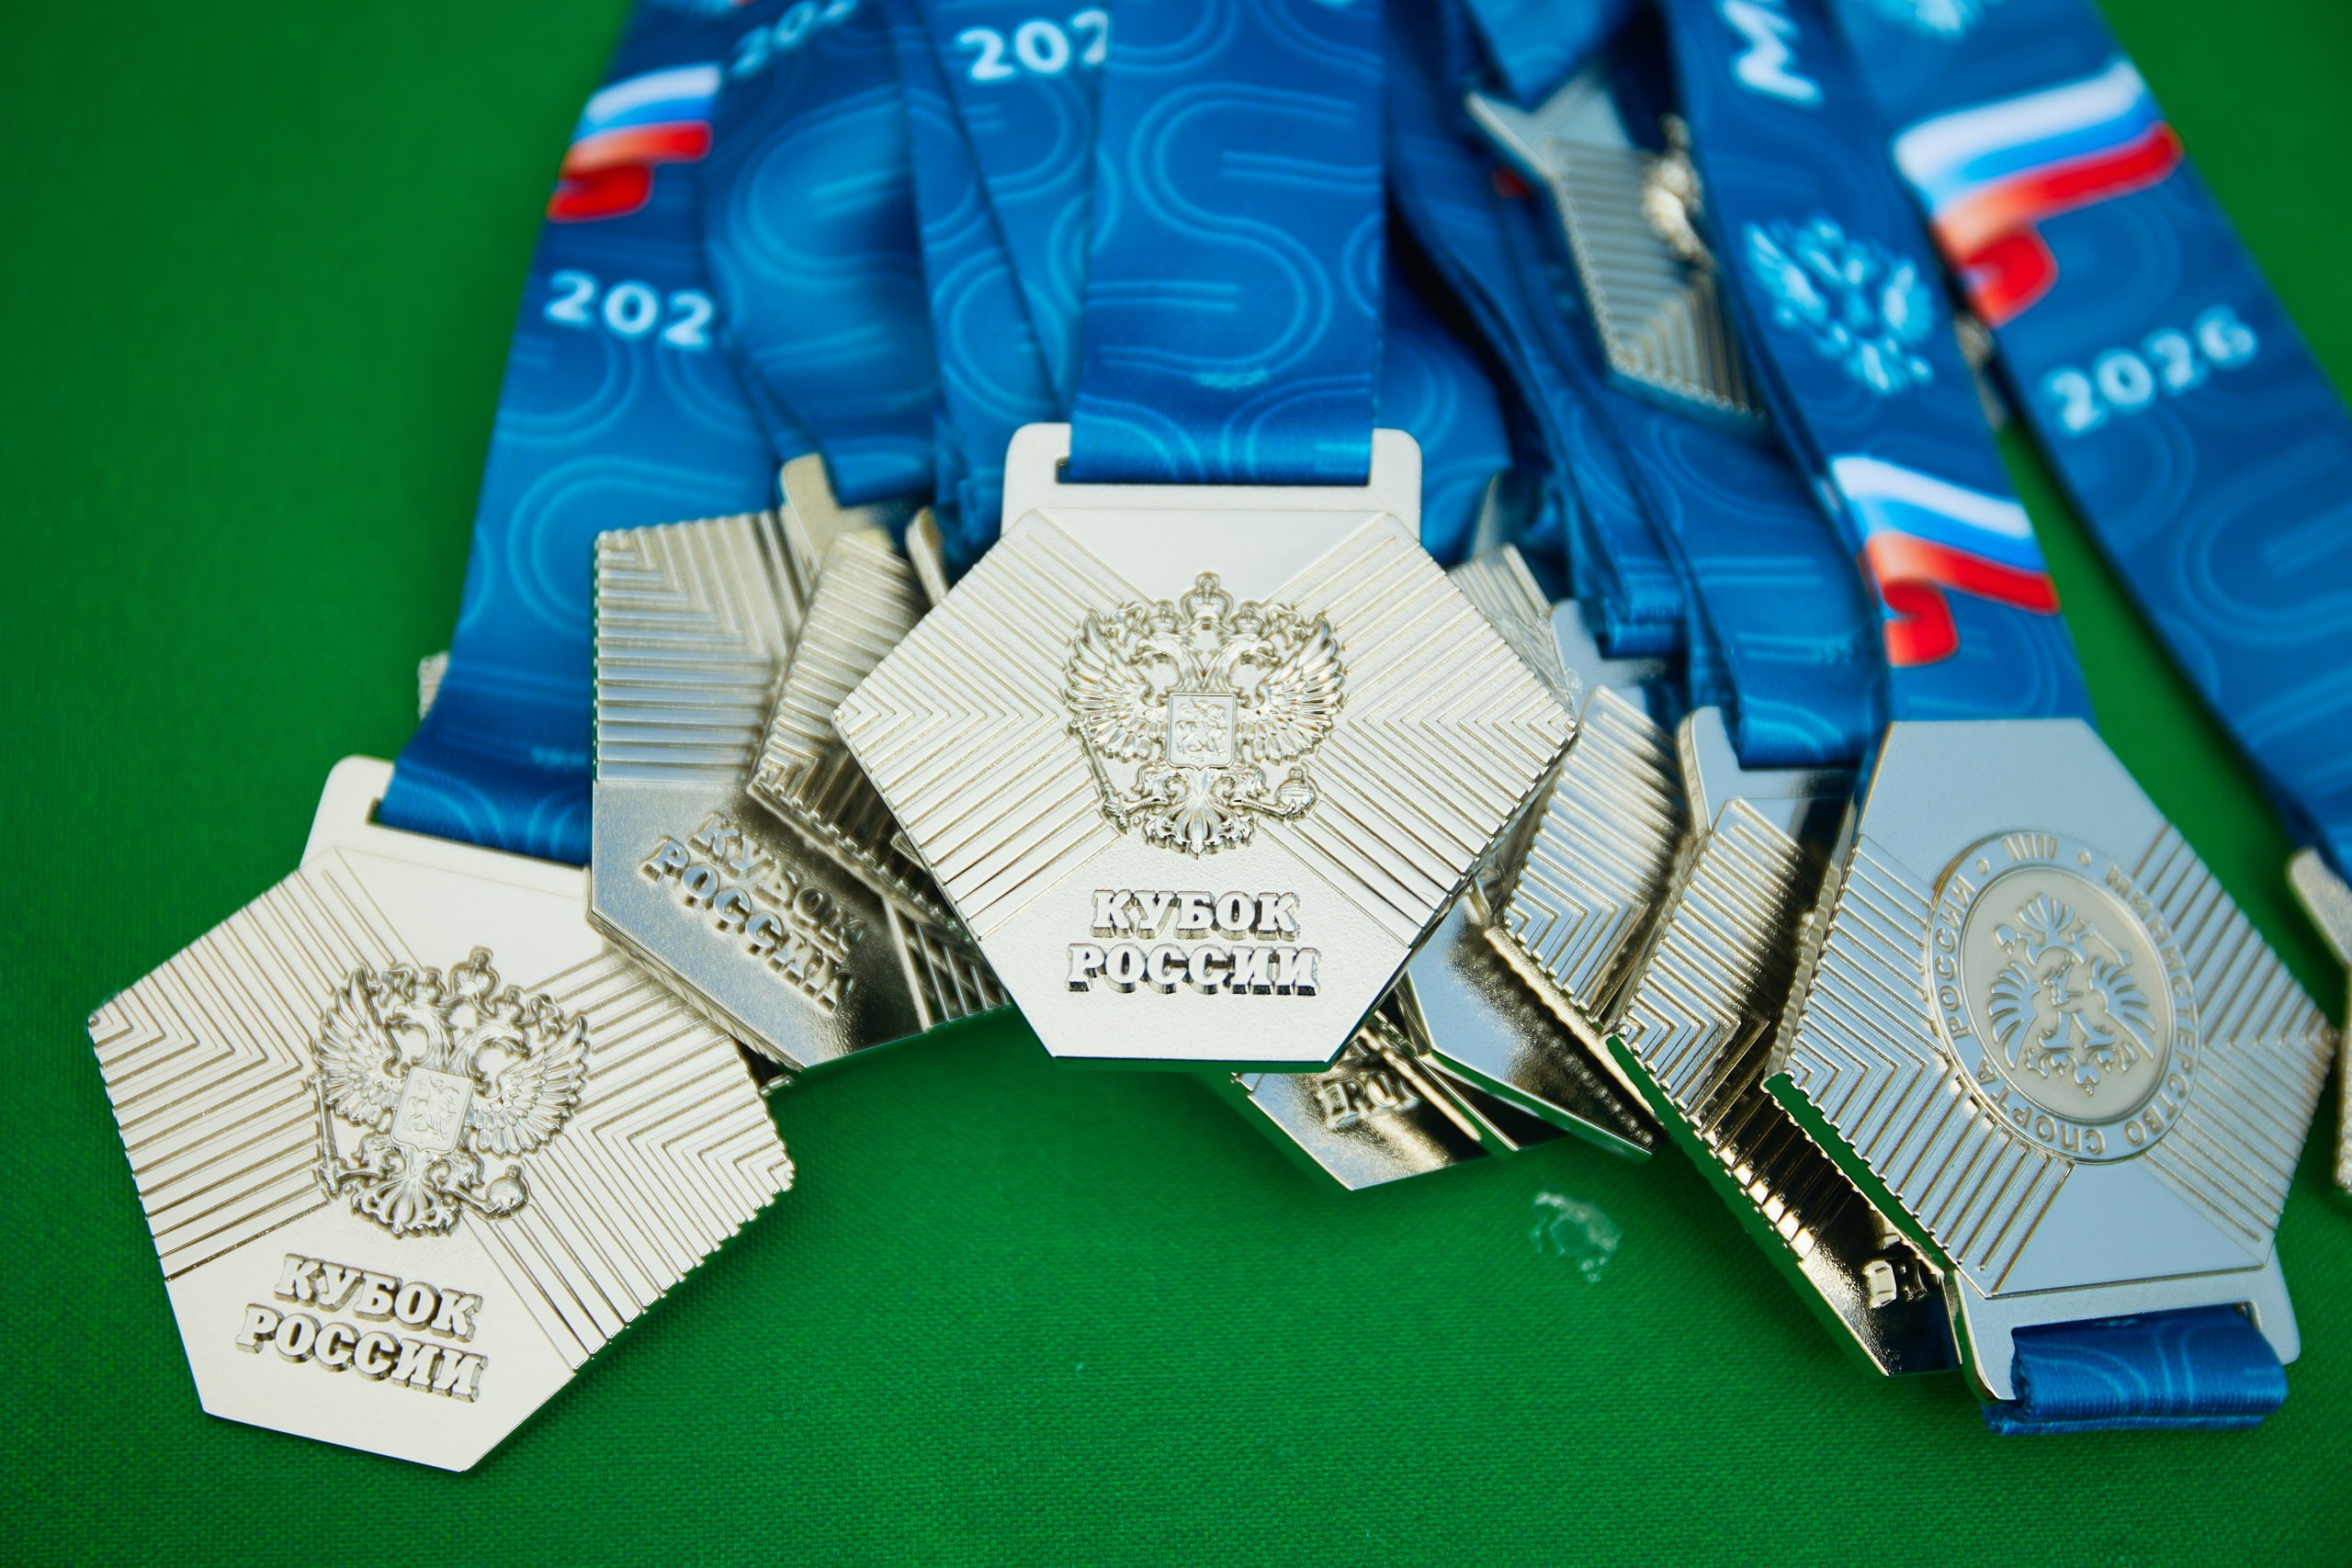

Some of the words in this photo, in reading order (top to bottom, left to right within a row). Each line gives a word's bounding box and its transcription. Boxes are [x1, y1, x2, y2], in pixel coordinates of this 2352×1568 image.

[956, 8, 1109, 83] 202
[544, 269, 714, 349] 202
[2044, 305, 2257, 434] 2026
[639, 834, 856, 1014] РОССИИ
[687, 809, 865, 964] КУБОК
[1090, 888, 1301, 942] КУБОК
[1065, 942, 1322, 997] РОССИИ
[1934, 874, 1976, 1041] РОССИИ
[1976, 1055, 2107, 1156] СПОРТА
[274, 1252, 484, 1344] КУБОК
[235, 1303, 490, 1404] РОССИИ
